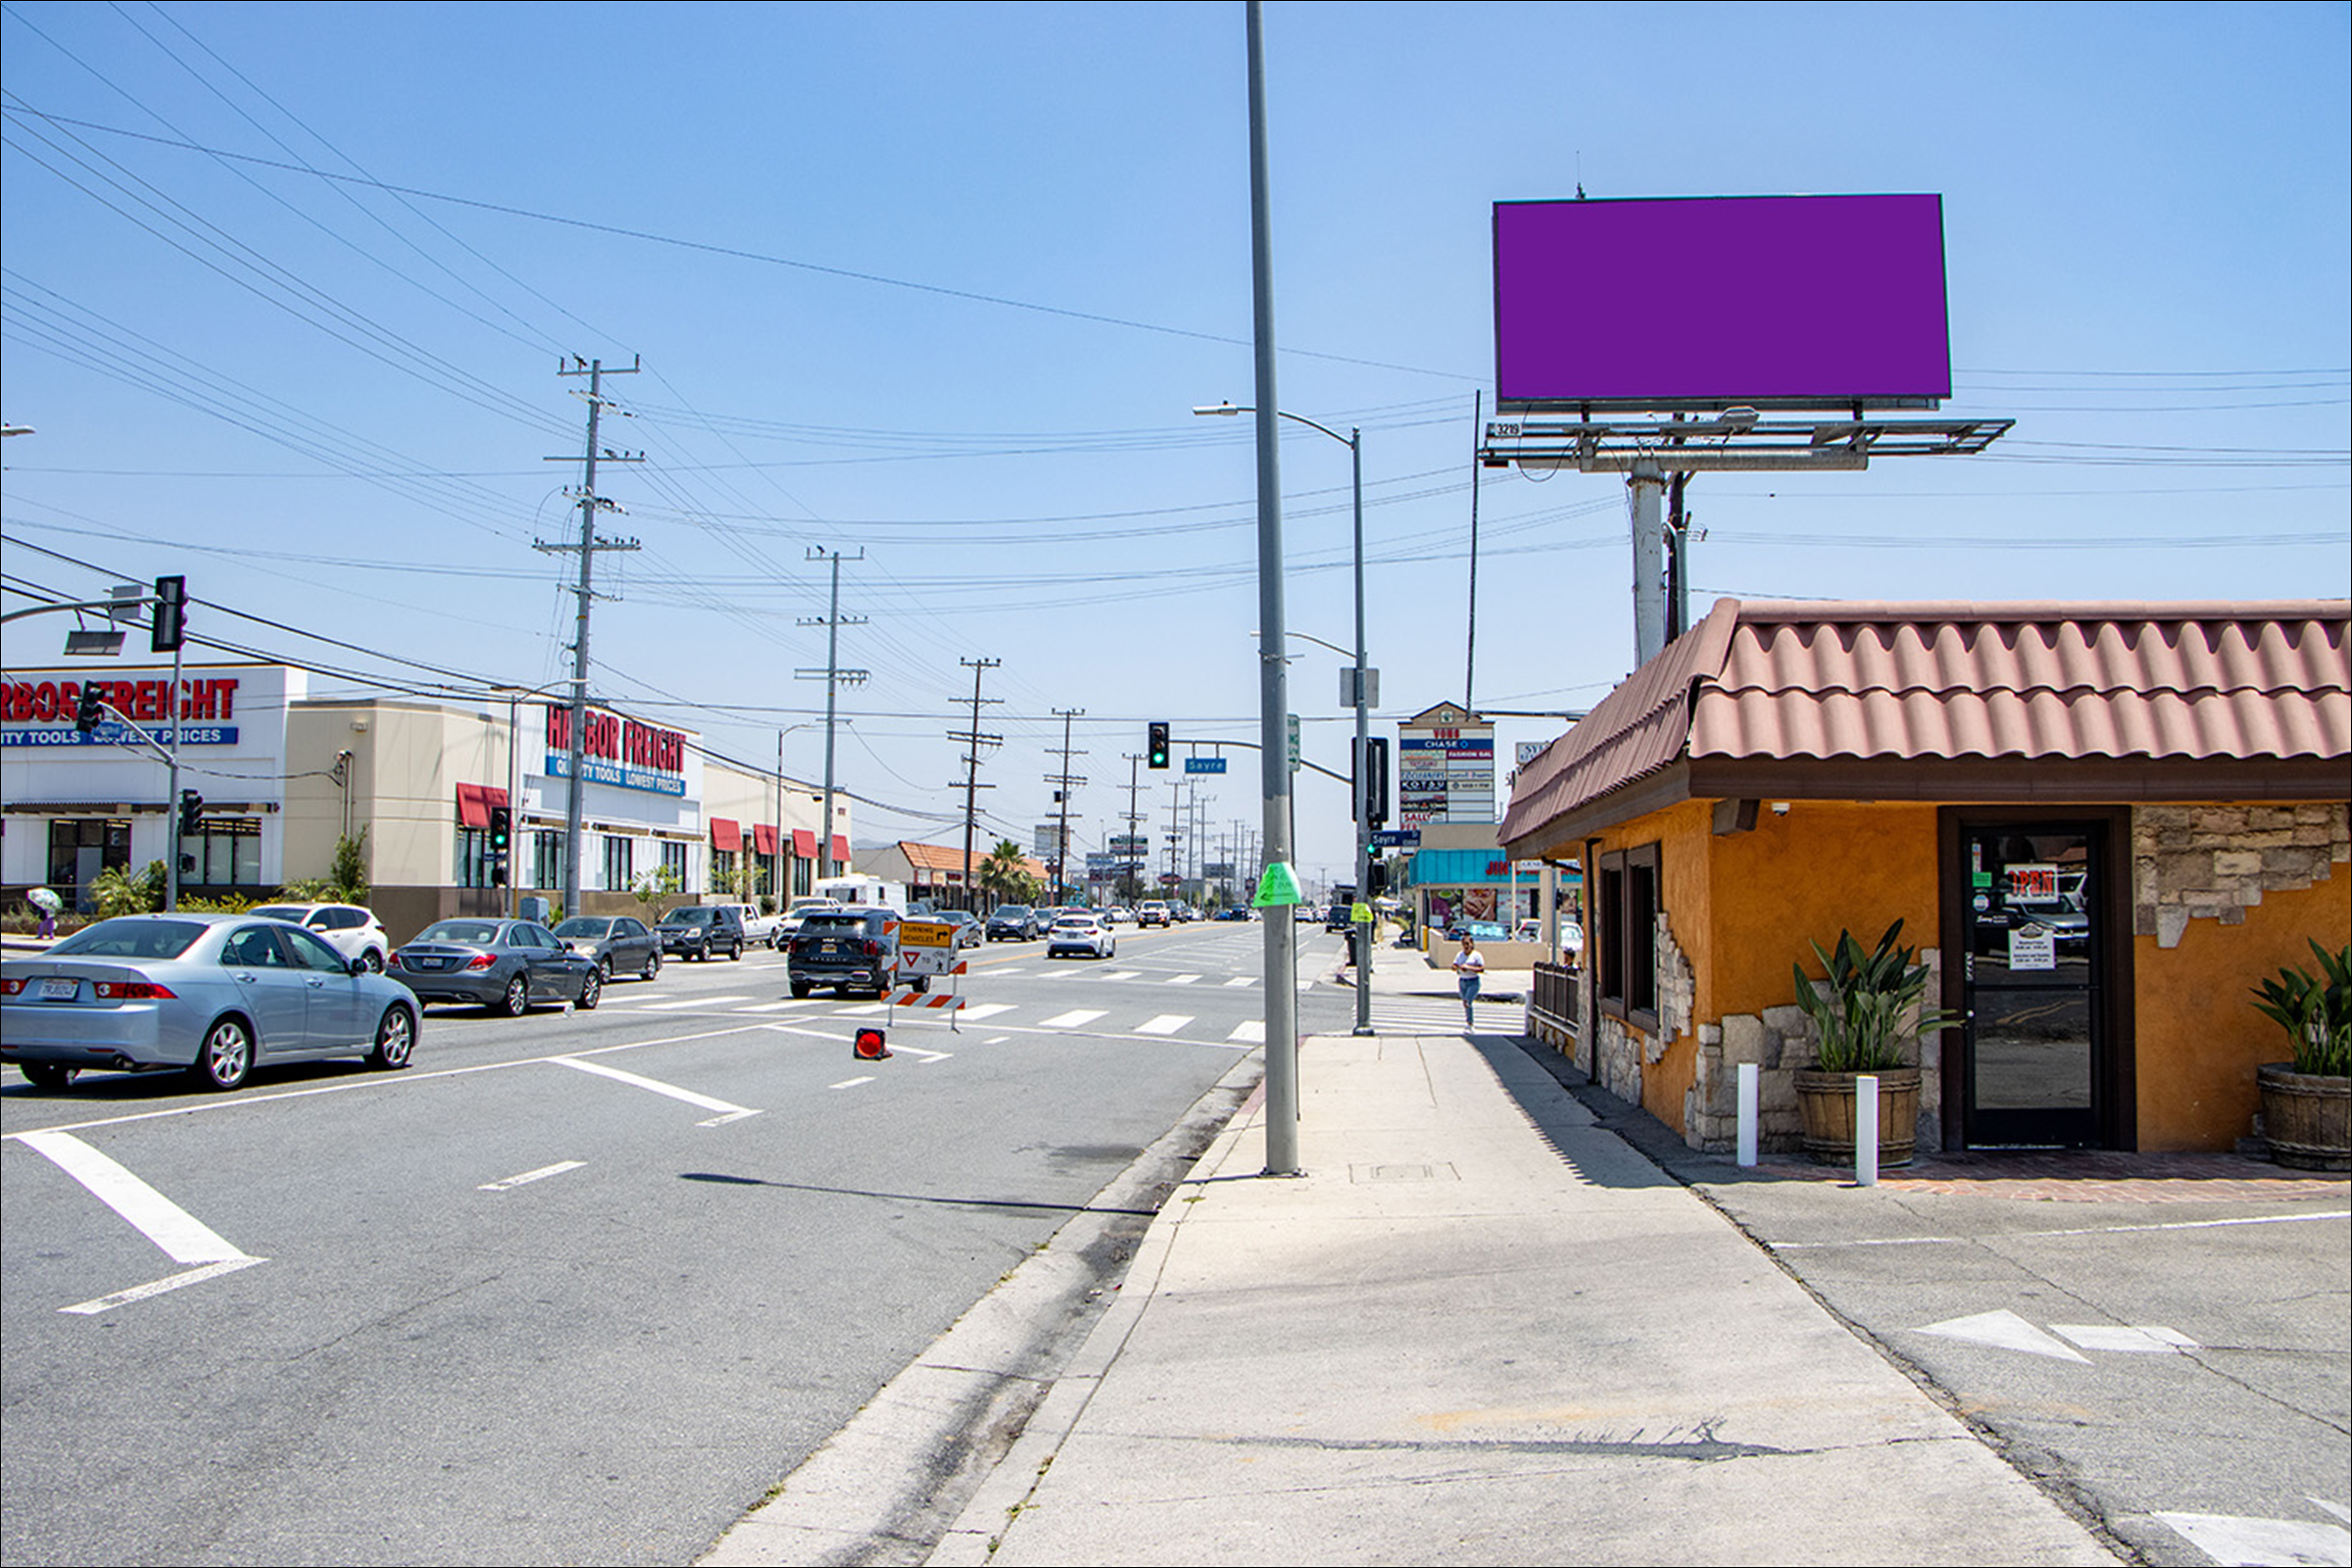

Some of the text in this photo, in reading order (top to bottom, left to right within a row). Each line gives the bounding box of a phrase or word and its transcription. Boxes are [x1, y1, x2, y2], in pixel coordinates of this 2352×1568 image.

[1496, 423, 1520, 435] 3219
[28, 731, 81, 744] TOOLS
[547, 705, 686, 772] HABOR FREIGHT
[1424, 740, 1458, 749] CHASE
[1189, 760, 1223, 771] Sayre
[596, 765, 621, 783] TOOLS
[626, 771, 655, 790] LOWEST
[657, 776, 682, 794] PRICES
[1372, 834, 1396, 846] Sayre
[903, 934, 934, 943] VEHICLES
